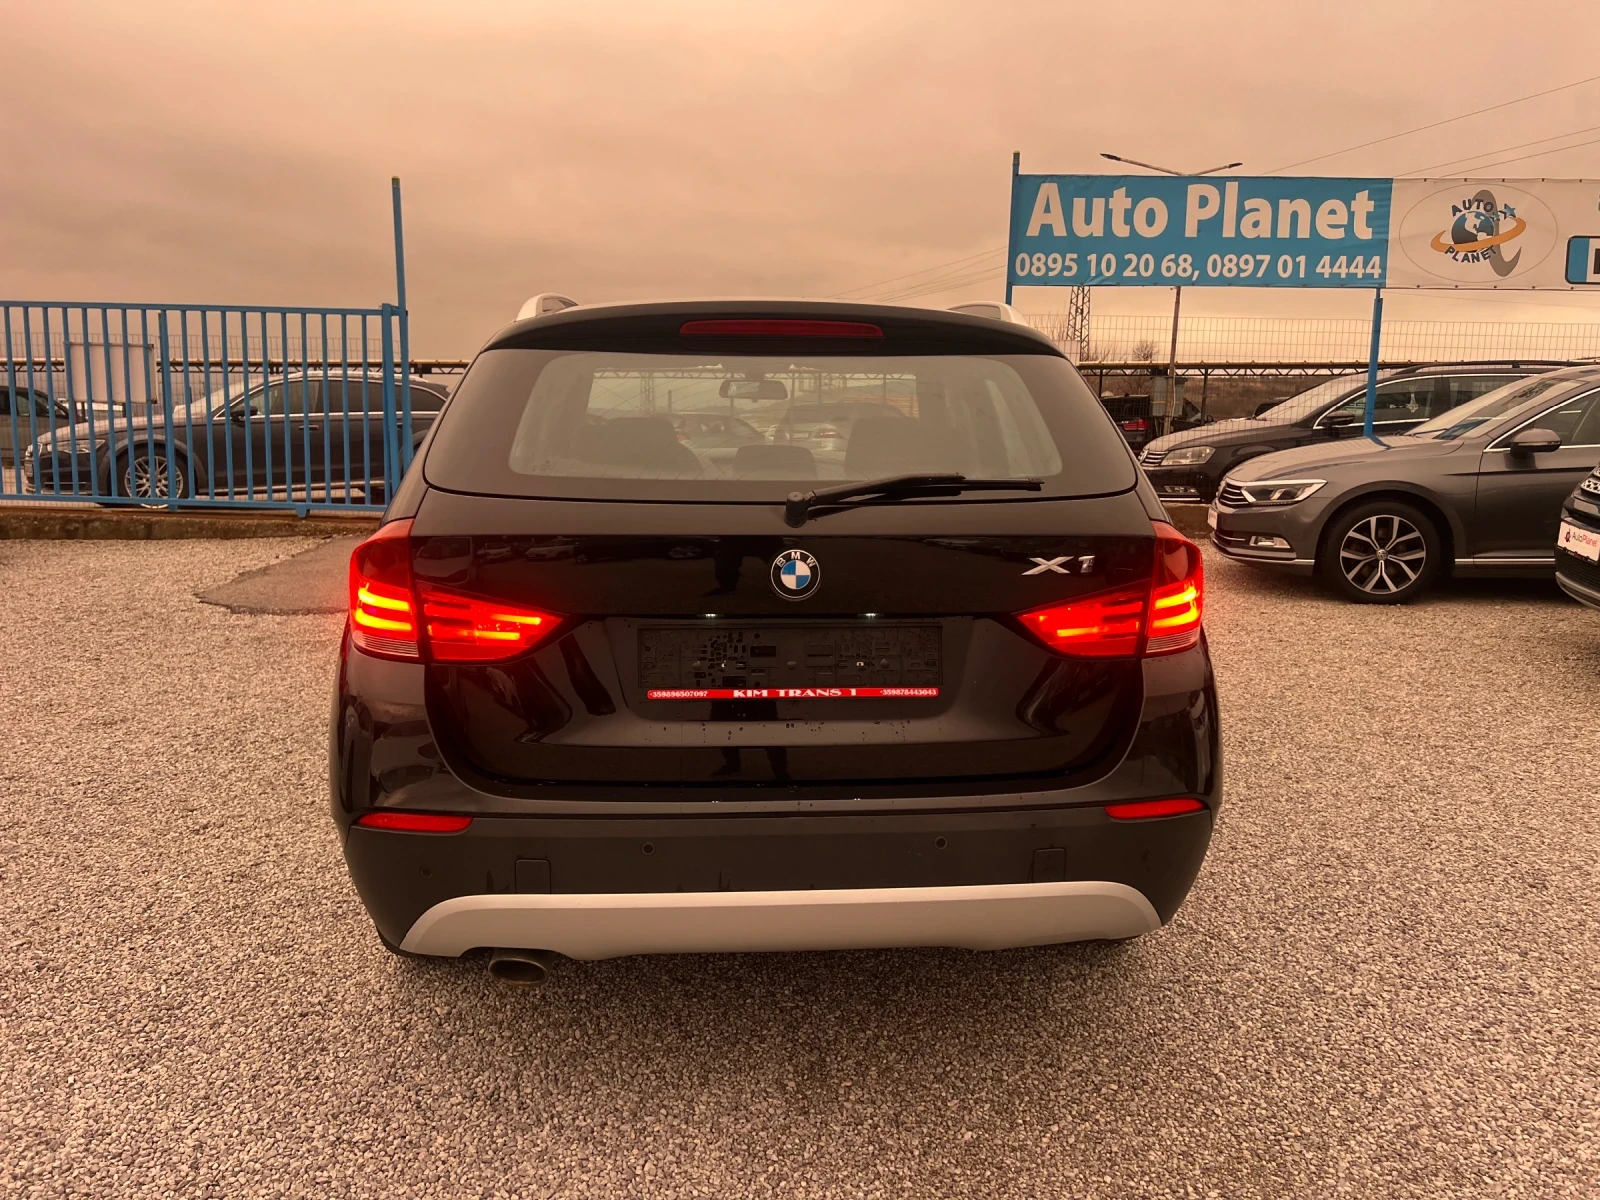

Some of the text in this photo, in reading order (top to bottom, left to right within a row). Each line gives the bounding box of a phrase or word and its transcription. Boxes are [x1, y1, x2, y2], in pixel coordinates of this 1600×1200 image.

[1025, 181, 1375, 240] Auto Planet
[1451, 198, 1495, 217] AUTO
[1444, 244, 1497, 264] PLANET
[1015, 252, 1382, 281] 0895 10 20 68, 0897 01 4444
[776, 551, 816, 568] BMW
[1021, 555, 1096, 576] X1
[733, 689, 768, 698] KIM
[776, 688, 842, 697] TRANS
[848, 688, 857, 696] 1
